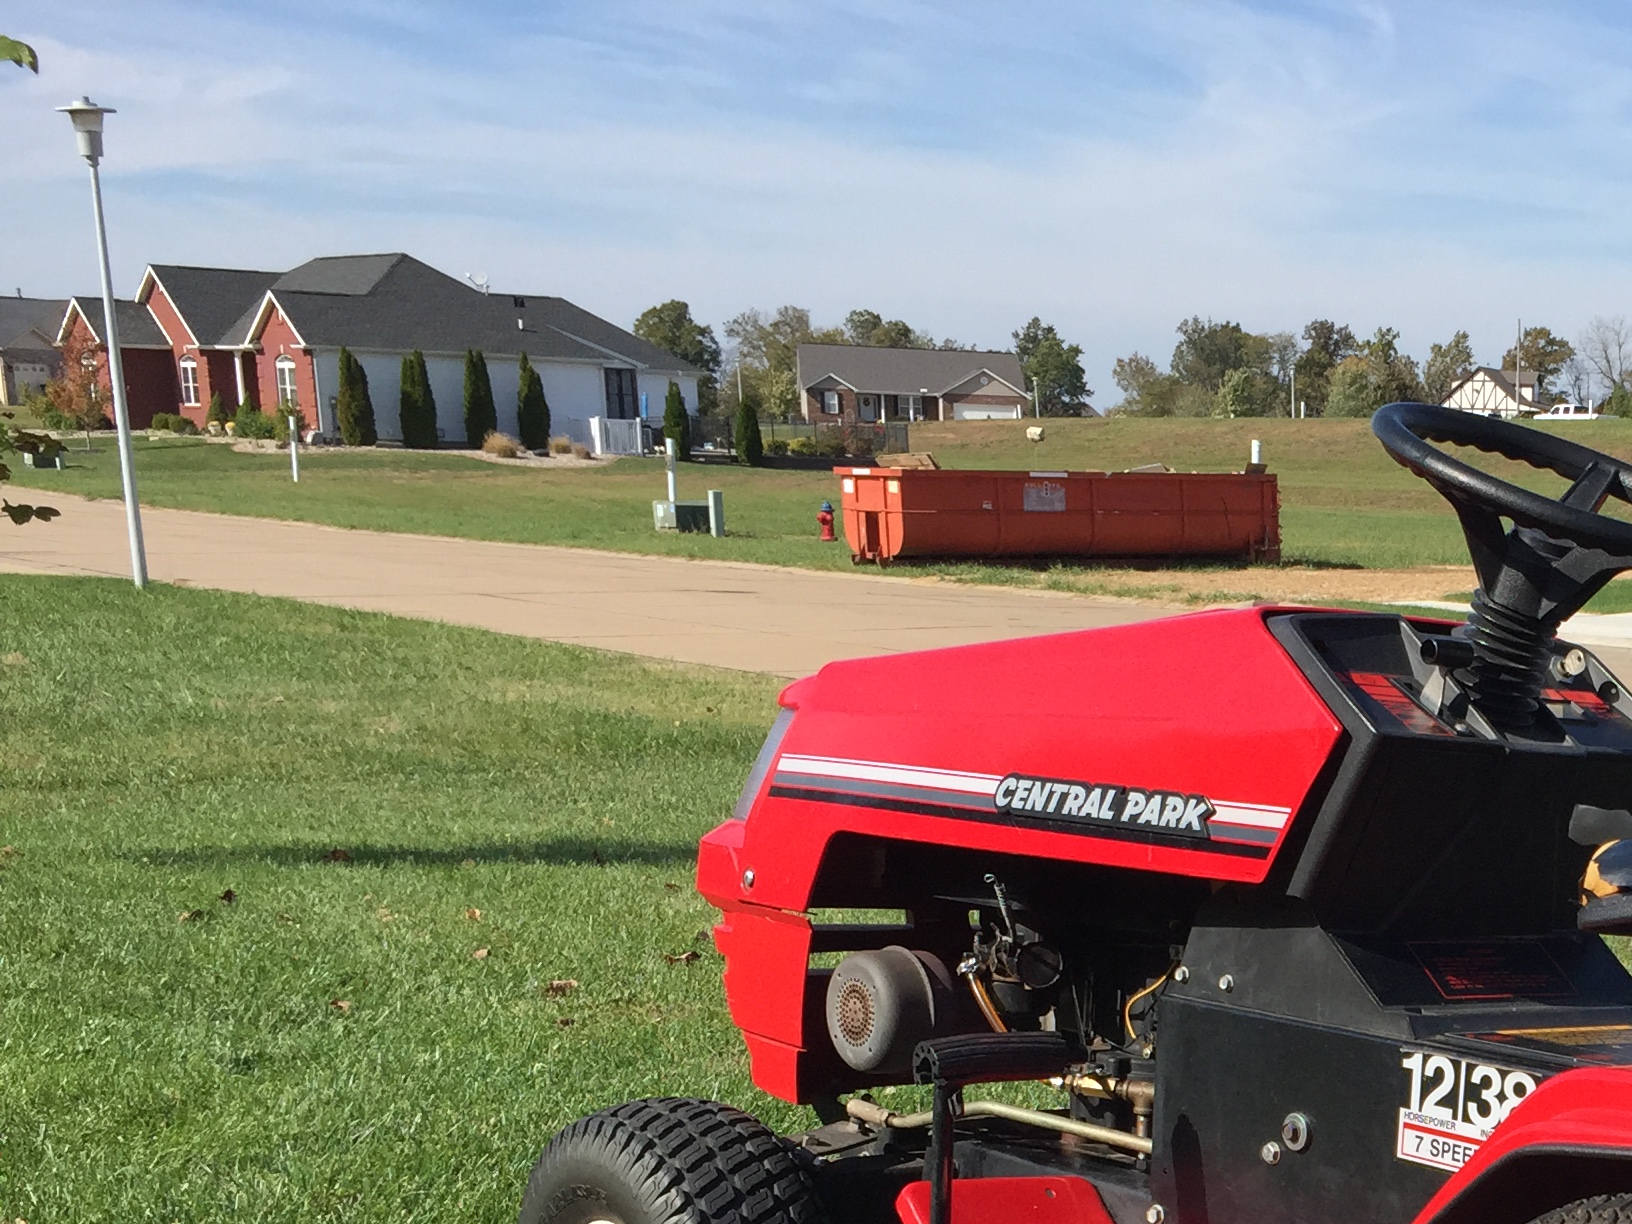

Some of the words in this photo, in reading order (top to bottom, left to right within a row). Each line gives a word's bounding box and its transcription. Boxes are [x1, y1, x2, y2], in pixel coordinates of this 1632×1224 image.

[996, 778, 1115, 820] CENTRAL
[1120, 793, 1209, 831] PARK
[1402, 1053, 1455, 1120] 12
[1404, 1111, 1456, 1131] HORSEPOWER
[1415, 1135, 1424, 1153] 7
[1430, 1138, 1478, 1165] SPEE
